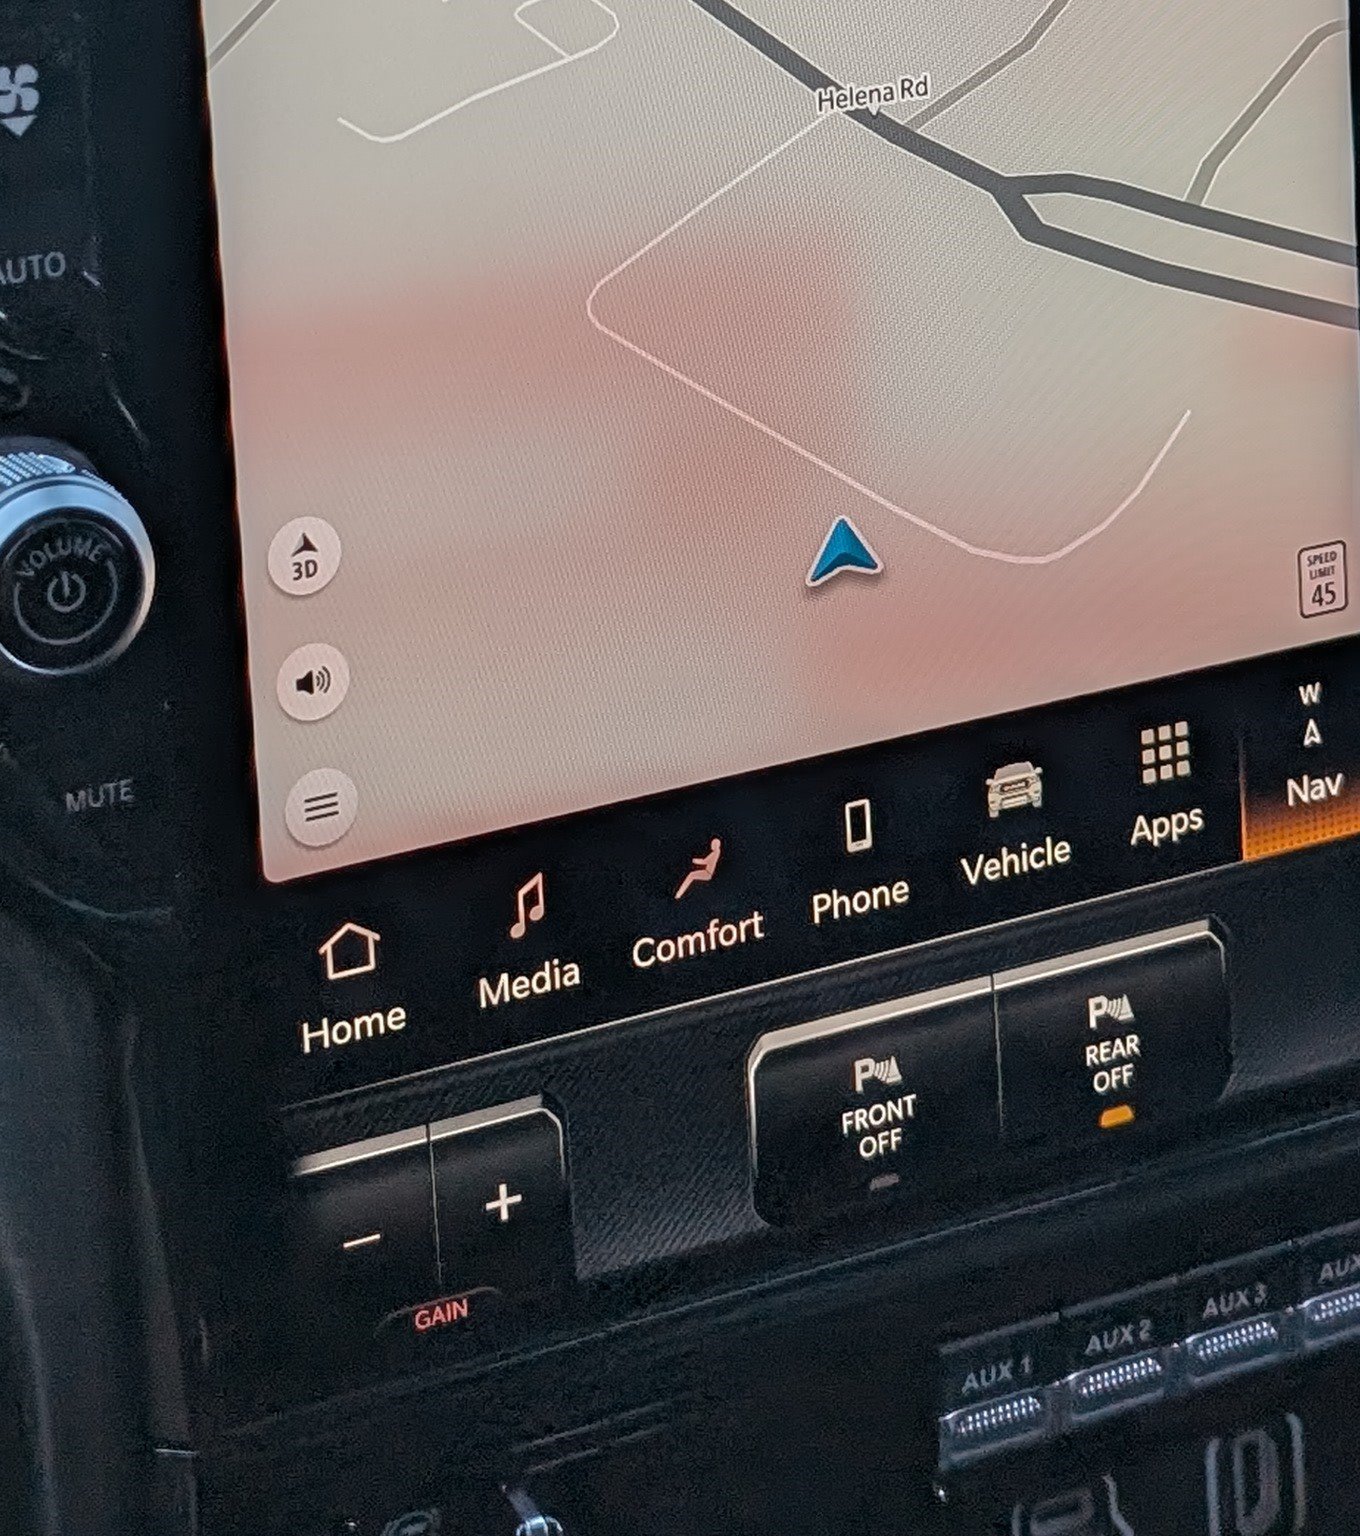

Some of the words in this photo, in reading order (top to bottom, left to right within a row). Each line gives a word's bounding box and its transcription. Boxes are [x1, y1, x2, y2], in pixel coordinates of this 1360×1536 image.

[818, 82, 894, 112] Helena
[899, 75, 930, 100] Rd
[16, 535, 113, 576] VOLUME
[291, 556, 320, 583] 3D
[1307, 550, 1338, 567] SPEED
[1309, 565, 1336, 581] LIMIT
[1311, 582, 1337, 607] 45
[1299, 681, 1322, 706] W
[65, 777, 135, 814] MUTE
[1287, 772, 1344, 807] Nav
[1130, 804, 1204, 847] Apps
[961, 835, 1072, 887] Vehicle
[812, 875, 910, 925] Phone
[632, 910, 765, 970] Comfort
[478, 958, 582, 1010] Media
[300, 1002, 407, 1054] Home
[1086, 1033, 1141, 1067] REAR
[1093, 1064, 1135, 1094] OFF
[842, 1093, 917, 1136] FRONT
[859, 1127, 902, 1159] OFF
[415, 1298, 468, 1330] GAIN
[1203, 1293, 1252, 1318] AUX
[1255, 1282, 1267, 1304] 3
[1084, 1327, 1134, 1355] AUX
[1139, 1318, 1153, 1339] 2
[961, 1367, 1014, 1394] AUX
[1022, 1356, 1033, 1375] 1
